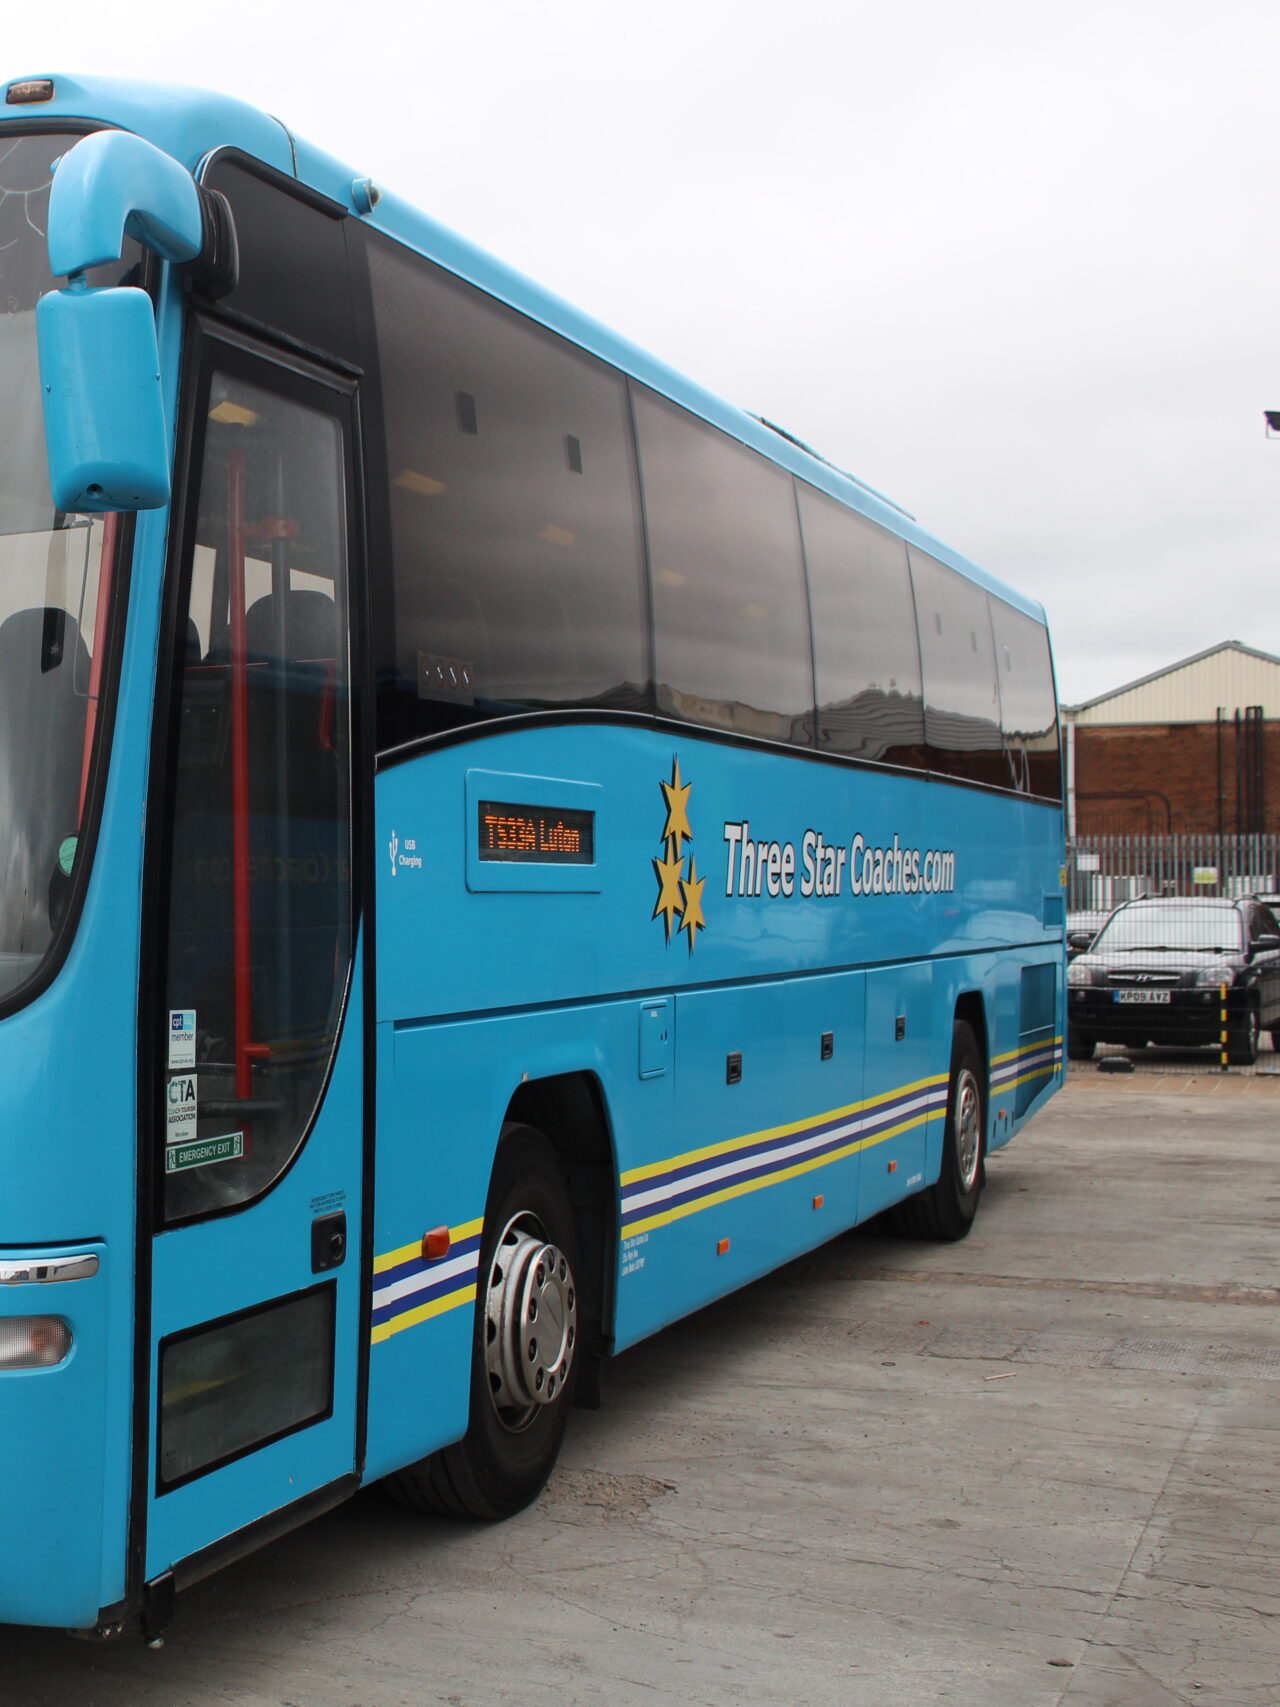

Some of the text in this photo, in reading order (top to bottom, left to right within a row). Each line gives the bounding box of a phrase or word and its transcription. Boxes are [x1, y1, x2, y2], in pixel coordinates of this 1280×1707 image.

[484, 815, 580, 852] TS33A Luton
[404, 839, 416, 850] USB
[399, 854, 422, 869] Charging
[723, 820, 955, 898] Three Star Coaches.com
[171, 1032, 194, 1041] member
[168, 1080, 196, 1104] CTA
[168, 1113, 196, 1124] ASSOCIATION
[179, 1142, 231, 1163] EMERGENCY EXIT
